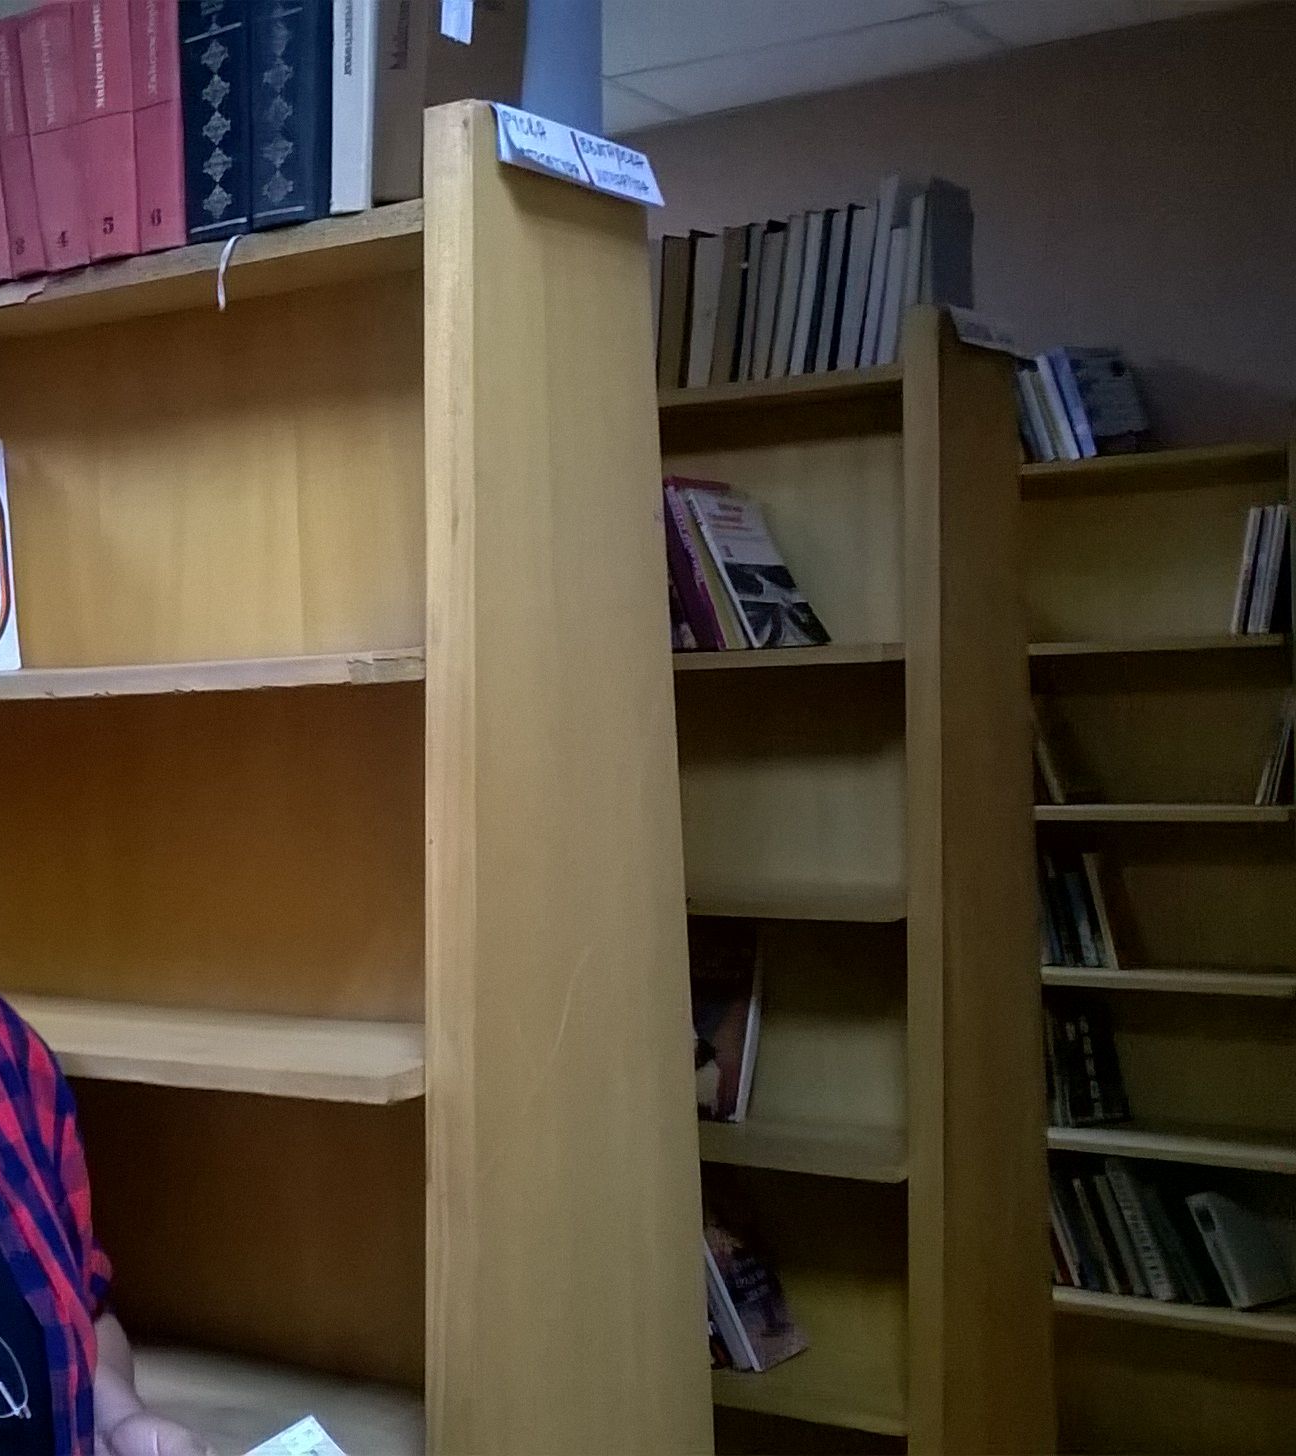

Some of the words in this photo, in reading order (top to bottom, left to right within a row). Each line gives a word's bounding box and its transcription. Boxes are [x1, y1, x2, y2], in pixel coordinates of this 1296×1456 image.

[102, 216, 114, 235] 5
[151, 208, 162, 226] 6
[57, 231, 69, 248] 4
